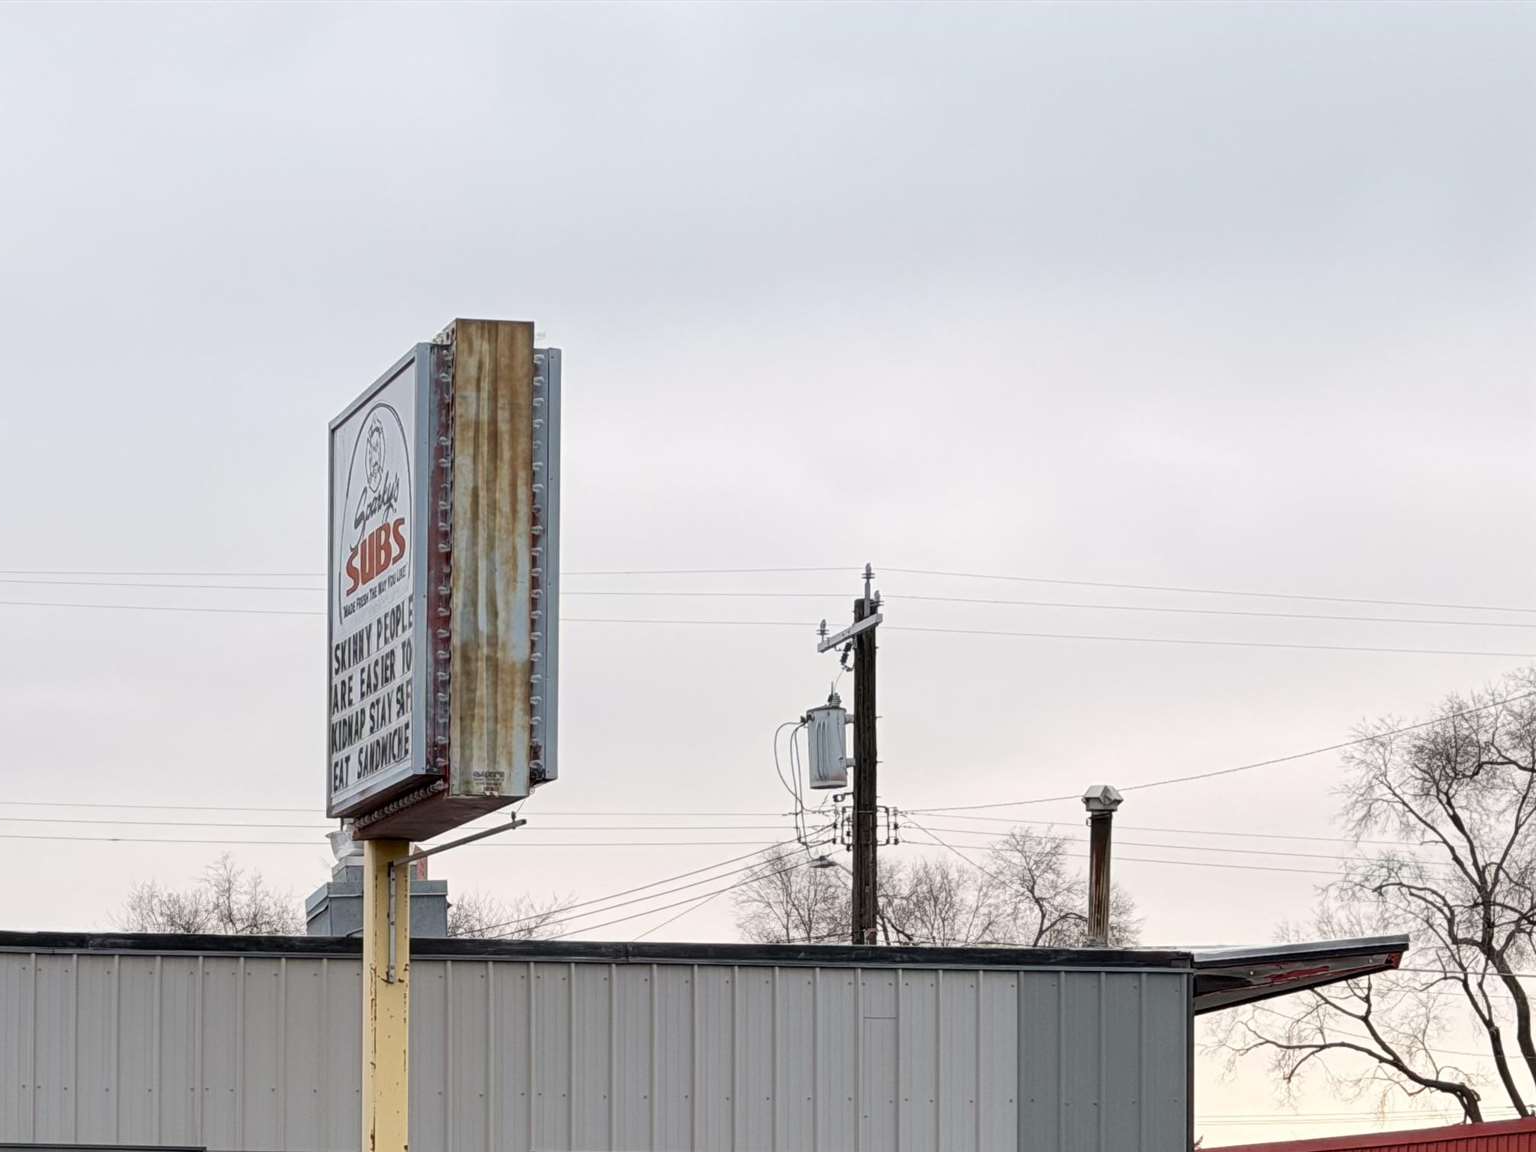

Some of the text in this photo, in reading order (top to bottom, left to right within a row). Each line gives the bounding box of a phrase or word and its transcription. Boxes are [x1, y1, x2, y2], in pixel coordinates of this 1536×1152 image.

[346, 517, 406, 597] SUBS
[334, 594, 413, 676] SKINNY PEOPLE
[332, 637, 412, 716] ARE EASIER TO
[331, 707, 366, 755] KIDNAP
[369, 689, 393, 735] STAY
[333, 754, 351, 793] EAT
